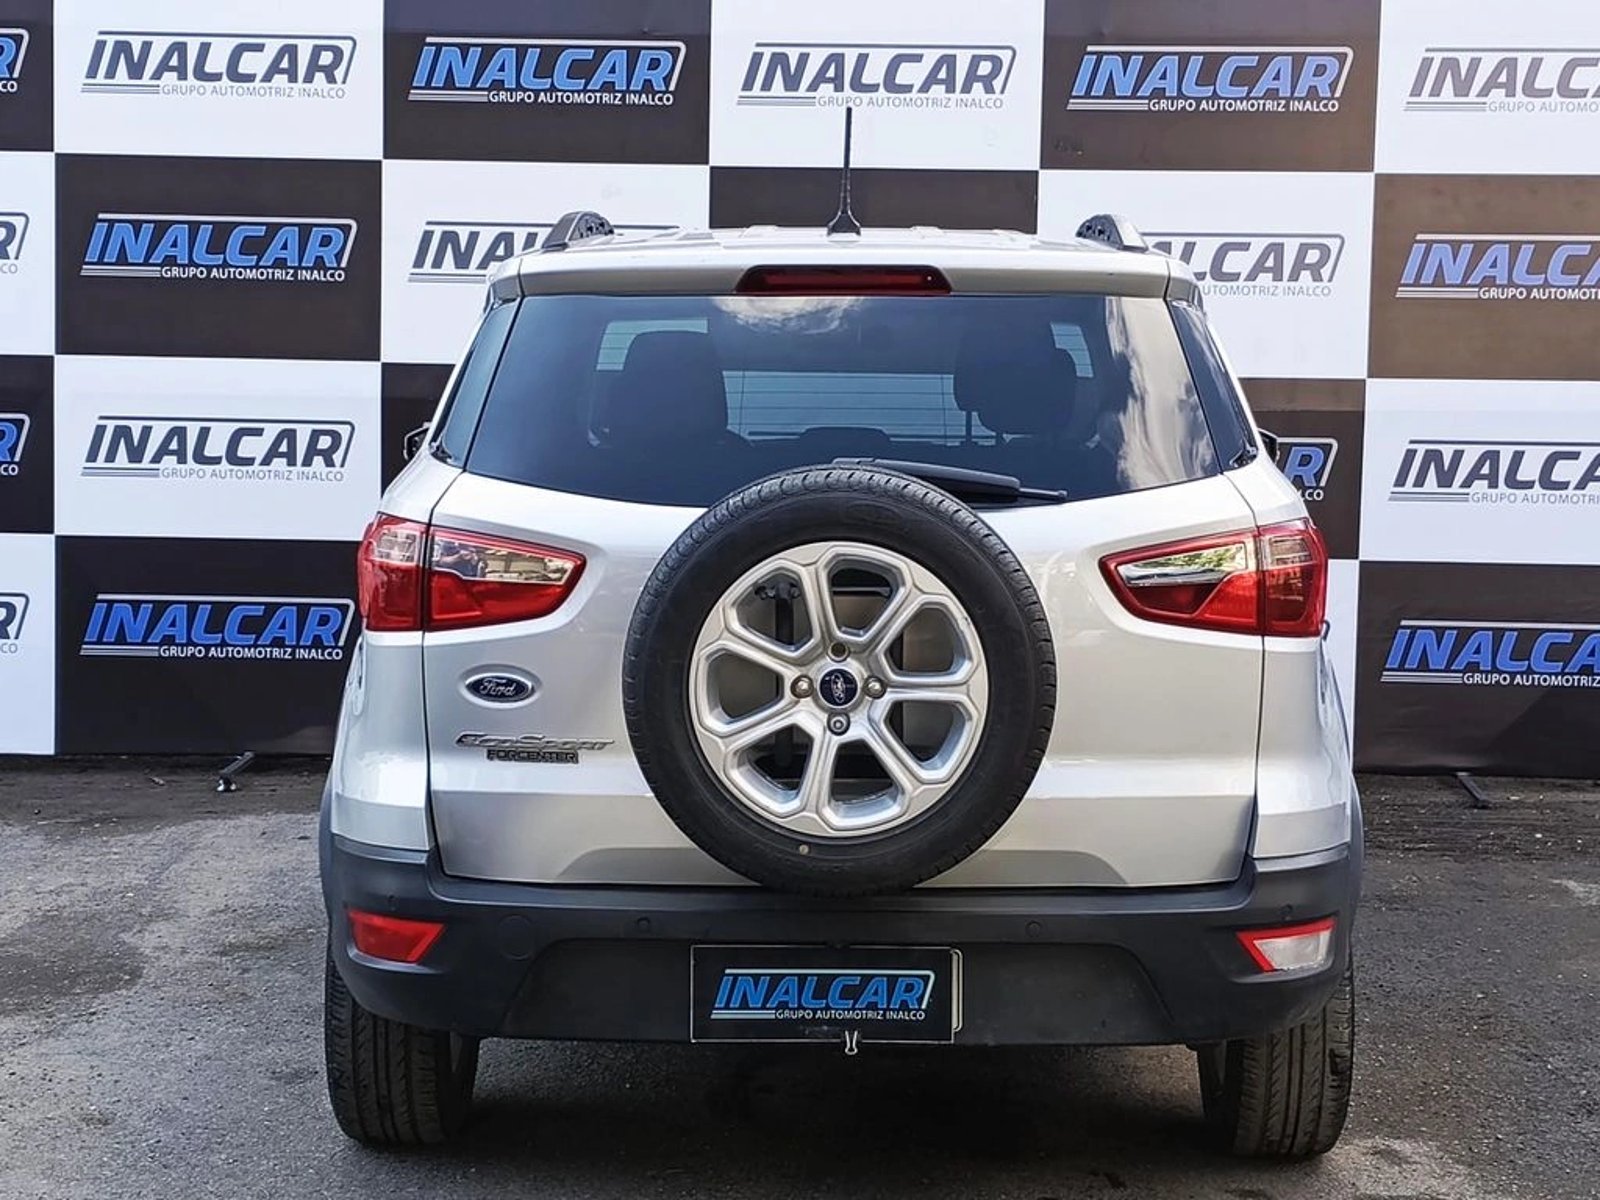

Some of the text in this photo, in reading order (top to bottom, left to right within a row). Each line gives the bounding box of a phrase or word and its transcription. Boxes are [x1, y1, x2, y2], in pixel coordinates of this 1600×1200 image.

[84, 38, 345, 84] INALCAR
[411, 46, 673, 91] INALCAR
[740, 51, 1004, 94] INALCAR
[1071, 55, 1340, 98] INALCAR
[1409, 57, 1600, 98] INALC
[162, 84, 346, 99] GRUPO AUTOMOTRIZ INALCO
[489, 91, 673, 106] GRUPO AUTOMOTRIZ INALCO
[817, 96, 1003, 109] GRUPO AUTOMOTRIZ INALCO
[1149, 100, 1338, 112] GRUPO AUTOMOTRIZ INALCO
[1488, 101, 1535, 113] GRUPO
[84, 222, 345, 268] INALCAR
[161, 267, 345, 281] GRUPO AUTOMOTRIZ INALCO
[1282, 285, 1331, 297] INALCO
[1479, 287, 1600, 300] GRUPO AUTOMOT
[84, 424, 343, 468] INALCAR
[161, 468, 344, 481] GRUPO AUTOMOTRIZ INALCO
[1471, 492, 1518, 503] GRUPO
[83, 602, 343, 647] INALCAR
[160, 646, 343, 660] GRUPO AUTOMOTRIZ INALCO
[479, 677, 516, 696] Ford
[1463, 673, 1510, 685] GRUPO
[714, 975, 925, 1009] INALCAR
[775, 1009, 926, 1021] GRUPO AUTOMOTRIZ INALCO
